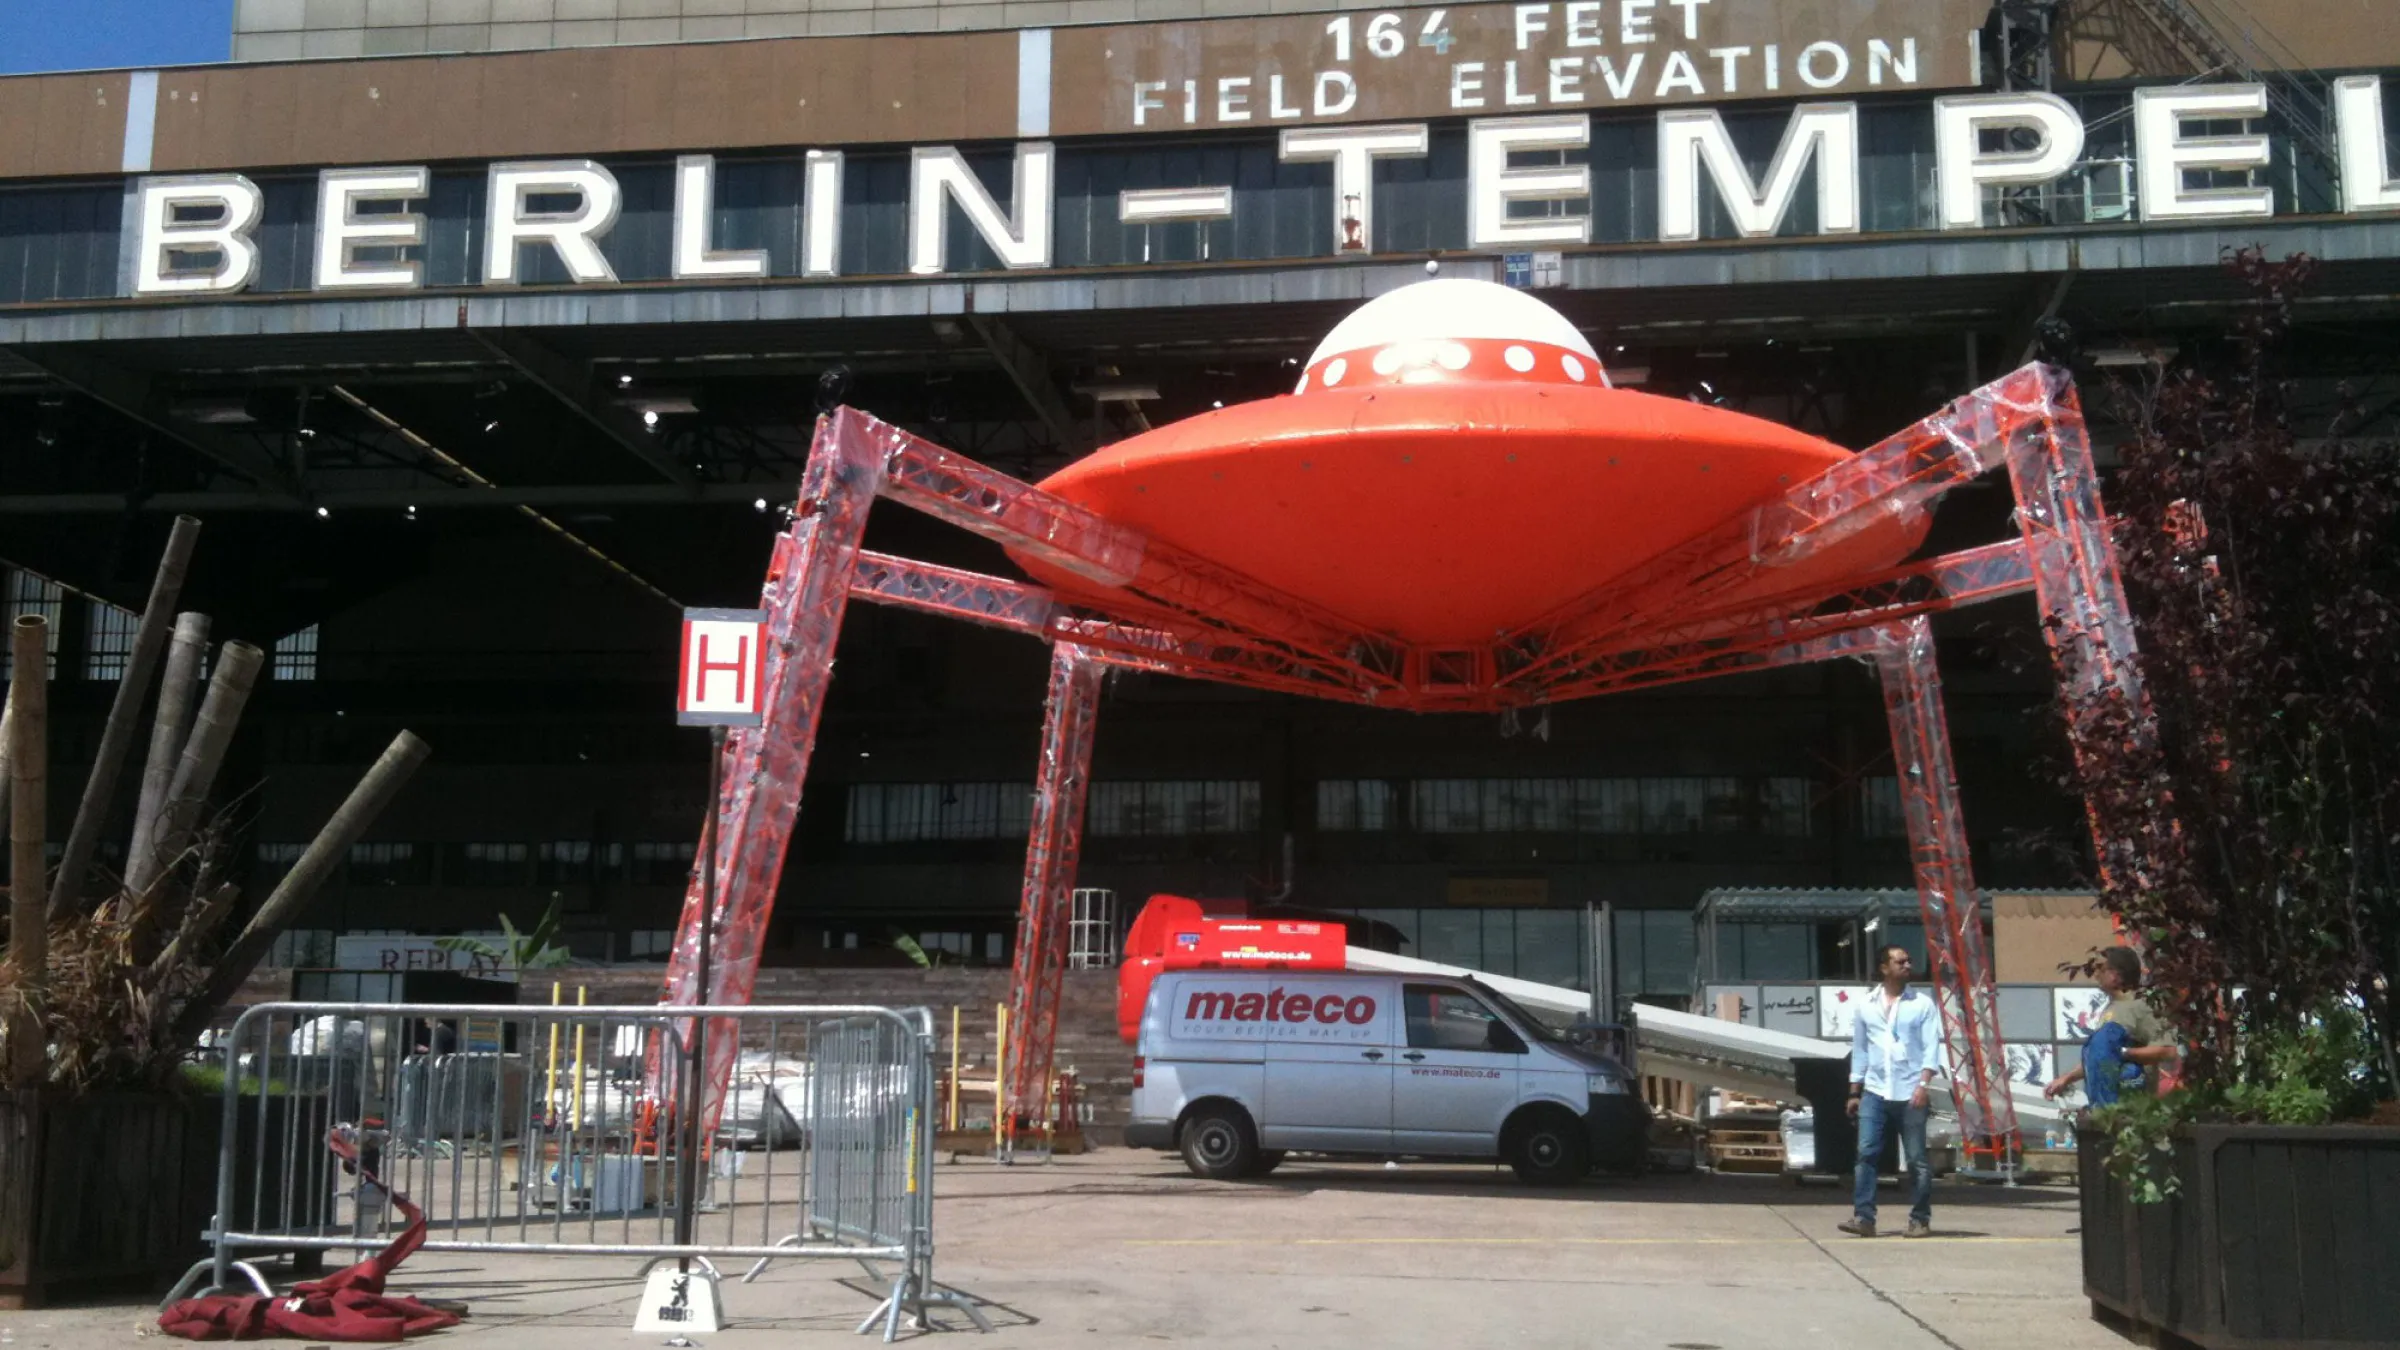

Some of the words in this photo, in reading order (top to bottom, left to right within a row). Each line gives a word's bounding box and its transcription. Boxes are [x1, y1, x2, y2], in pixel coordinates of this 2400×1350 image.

[1326, 12, 1457, 60] 164
[1516, 0, 1711, 50] FEET
[1134, 71, 1357, 125] FIELD
[1451, 38, 1916, 108] ELEVATION
[696, 634, 748, 703] H
[1221, 950, 1312, 961] www.mateco.de
[1184, 986, 1376, 1025] mateco
[1411, 1066, 1501, 1079] www.mateco.de
